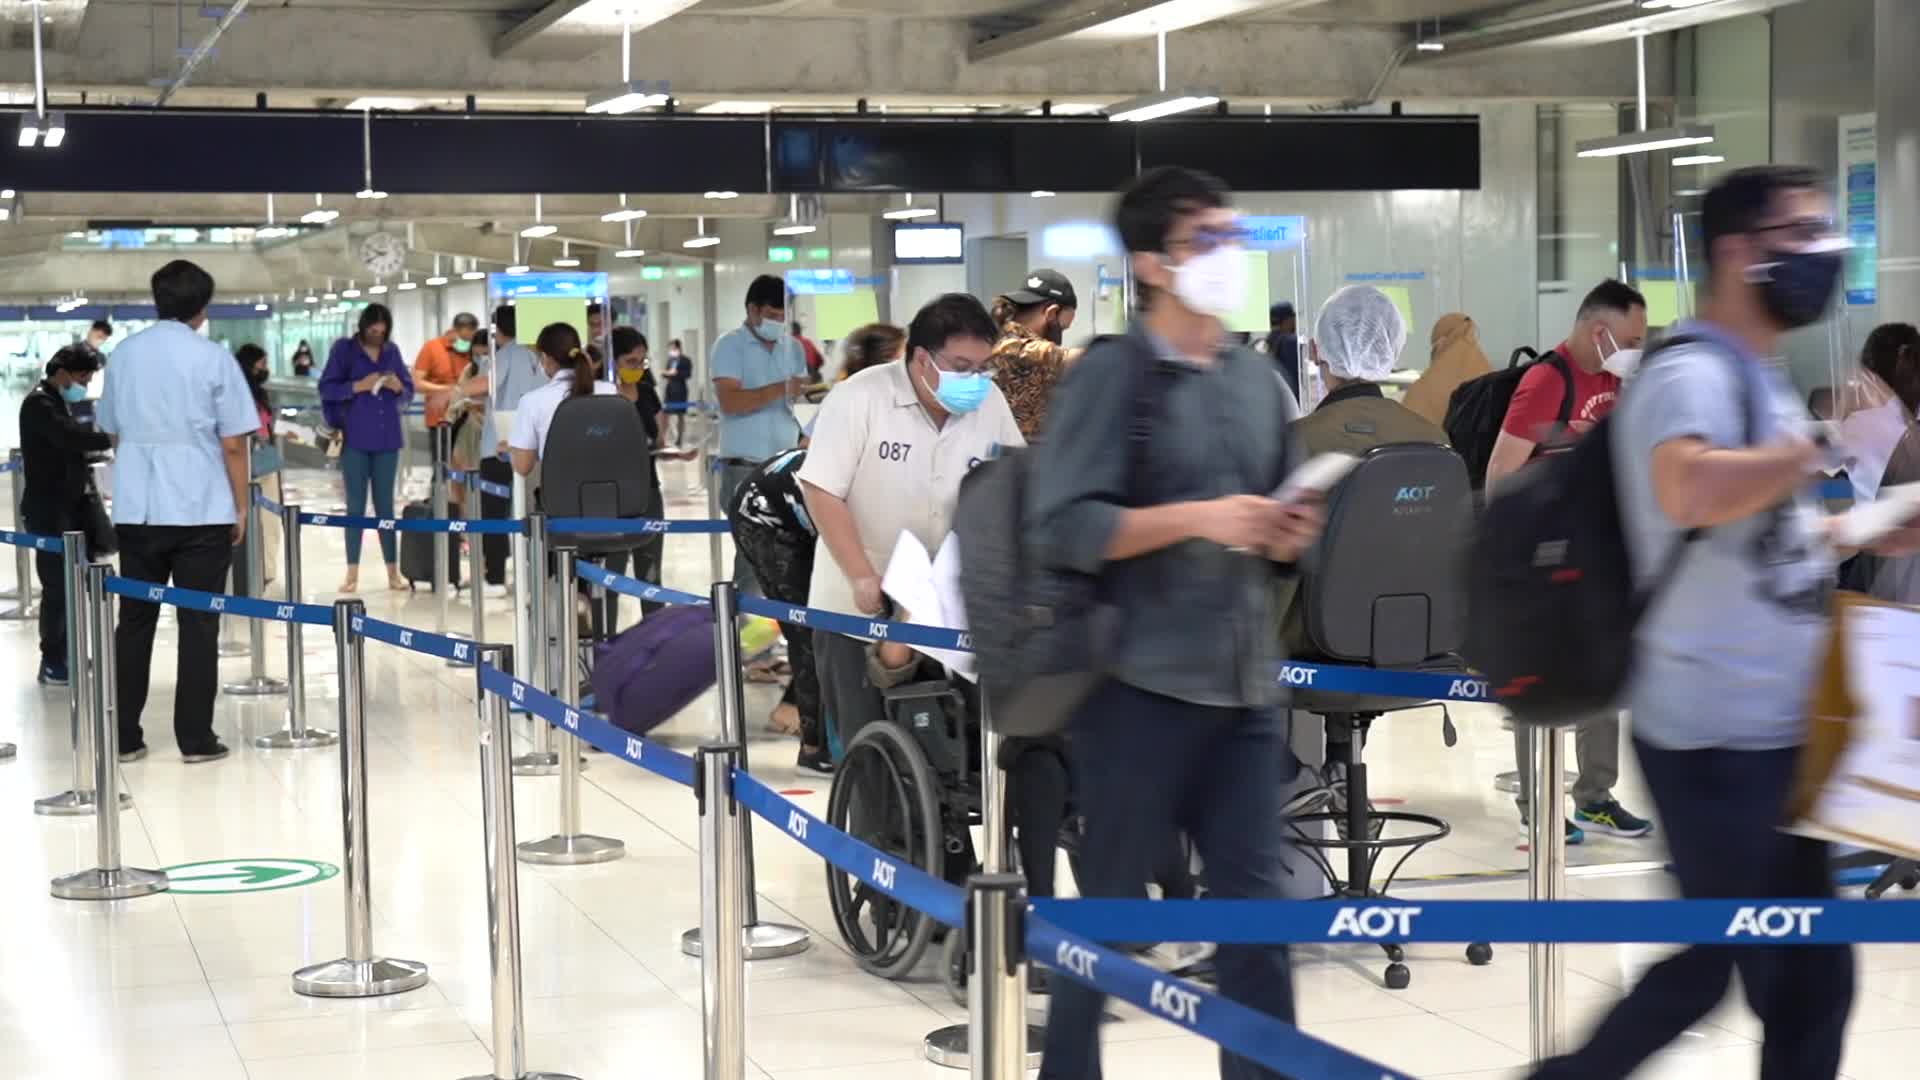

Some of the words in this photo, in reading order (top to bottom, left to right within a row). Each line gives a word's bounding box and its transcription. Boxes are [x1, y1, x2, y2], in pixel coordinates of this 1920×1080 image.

[878, 441, 912, 462] 087
[1394, 486, 1435, 501] AOT
[312, 515, 328, 525] AOT
[378, 519, 397, 530] AOT
[449, 521, 467, 532] AOT
[642, 520, 672, 533] AOT
[149, 588, 164, 600] AOT
[210, 597, 224, 610] AOT
[277, 606, 294, 619] AOT
[352, 617, 363, 631] AOT
[400, 629, 414, 645] AOT
[454, 643, 468, 658] AOT
[789, 609, 806, 623] AOT
[868, 623, 888, 638] AOT
[1277, 666, 1317, 684] AOT
[1449, 680, 1488, 697] AOT
[512, 681, 526, 701] AOT
[563, 708, 580, 731] AOT
[626, 737, 642, 759] AOT
[787, 809, 809, 840] AOT
[873, 859, 896, 888] AOT
[1328, 907, 1421, 937] AOT
[1726, 906, 1823, 936] AOT
[1056, 940, 1099, 980] AOT
[1150, 980, 1201, 1025] AOT
